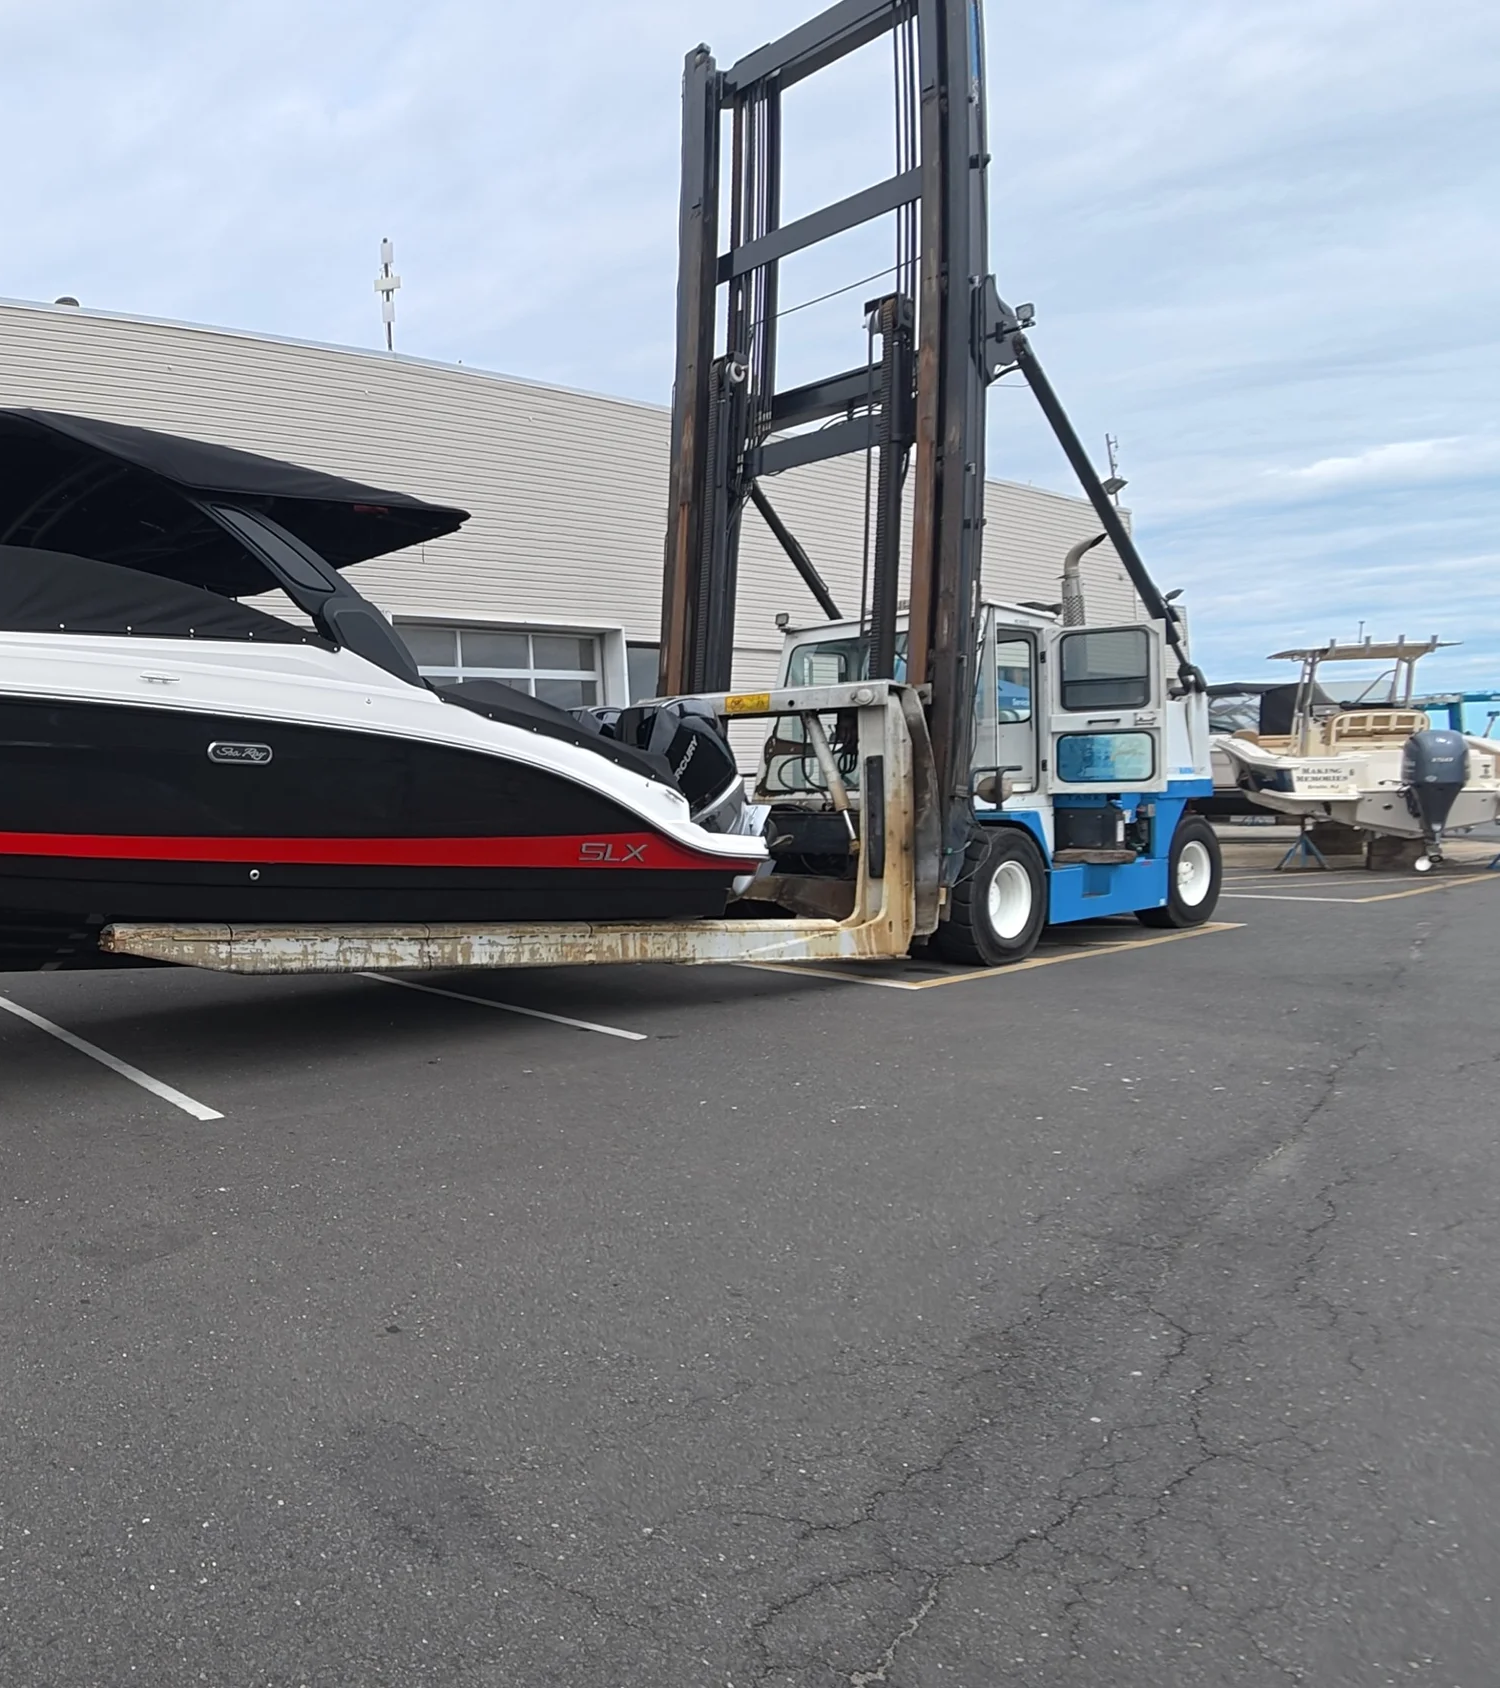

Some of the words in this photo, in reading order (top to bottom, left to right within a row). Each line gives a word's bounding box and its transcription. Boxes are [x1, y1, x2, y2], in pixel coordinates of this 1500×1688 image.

[216, 747, 241, 757] Sea
[242, 747, 267, 760] Ray
[674, 734, 698, 782] RCURY
[579, 843, 648, 862] SLX
